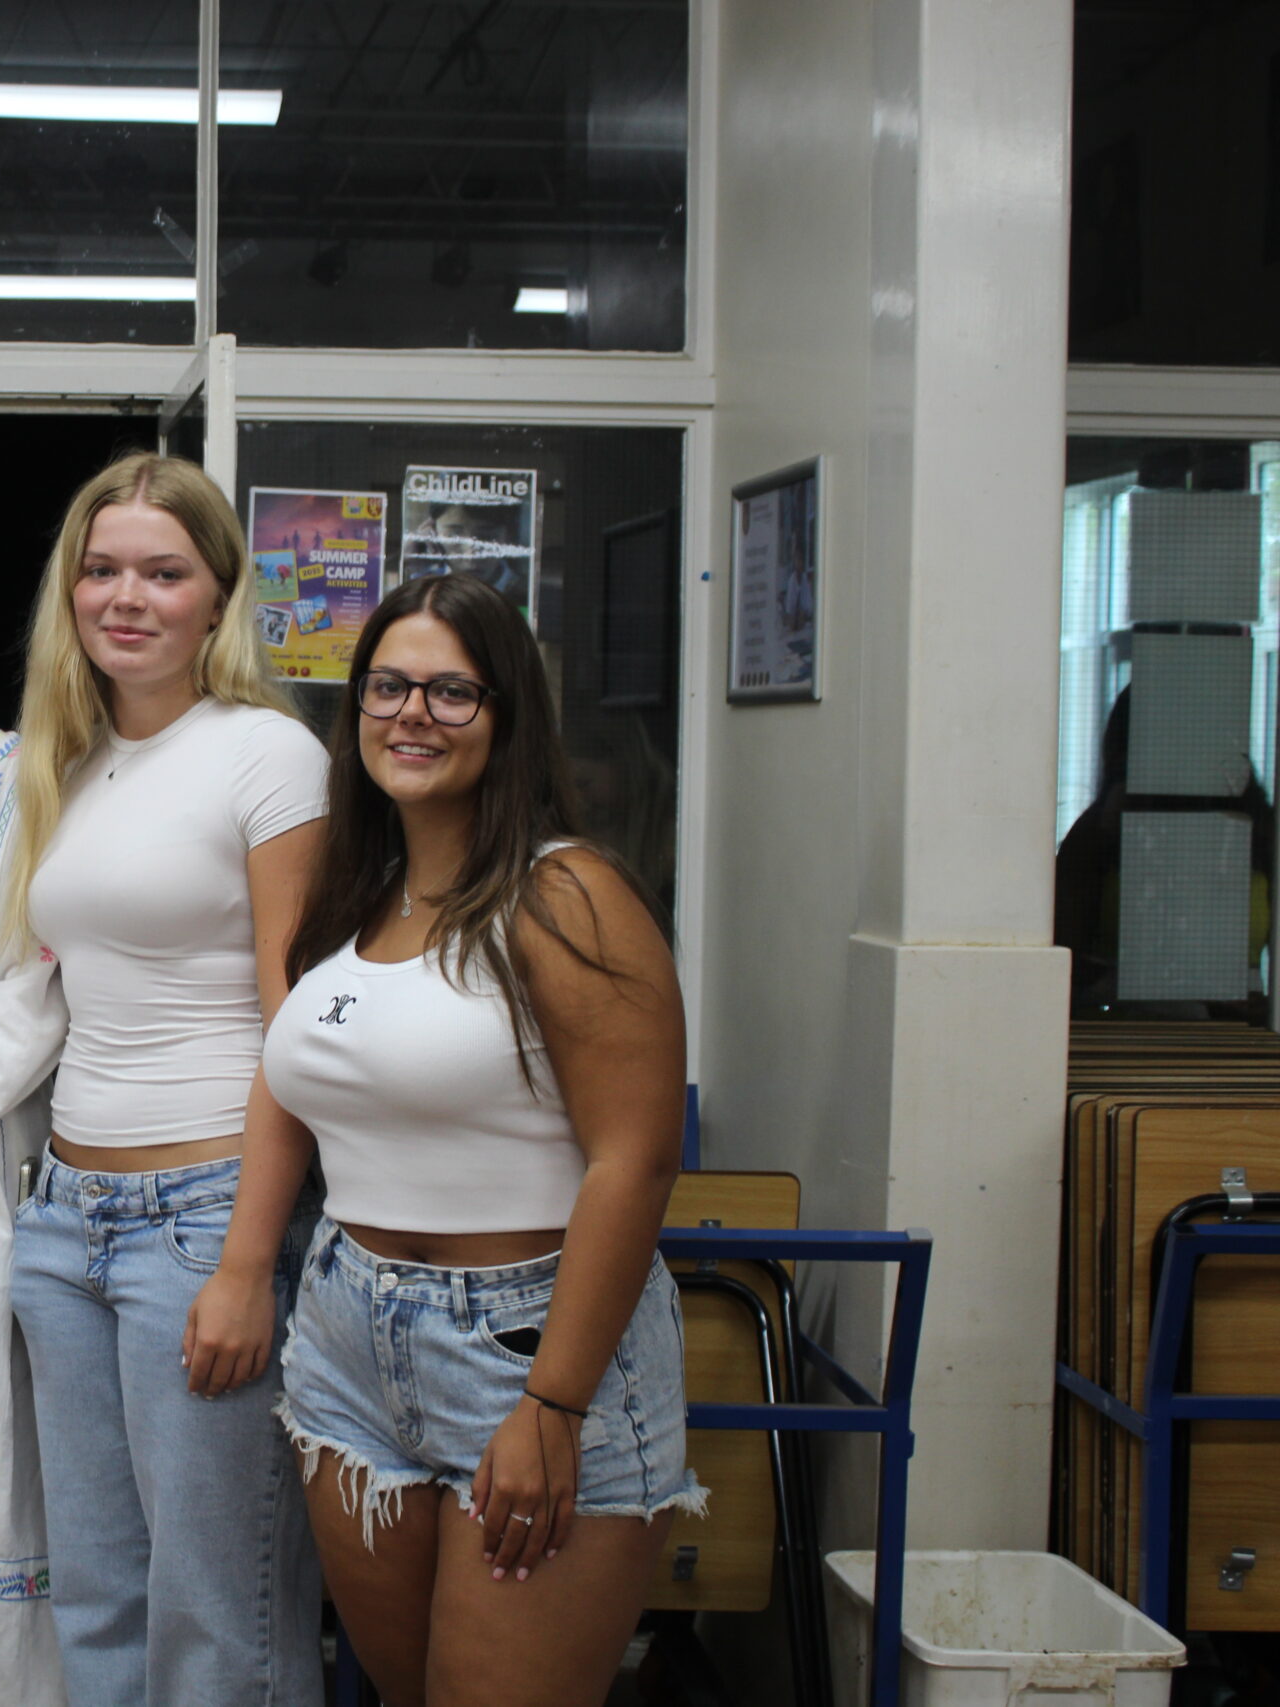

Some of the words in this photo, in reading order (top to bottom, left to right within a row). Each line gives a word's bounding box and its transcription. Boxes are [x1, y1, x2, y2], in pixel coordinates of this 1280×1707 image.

[409, 473, 529, 497] ChildLine
[309, 550, 368, 565] SUMMER
[326, 566, 366, 580] CAMP
[326, 579, 368, 588] ACTIVITIES
